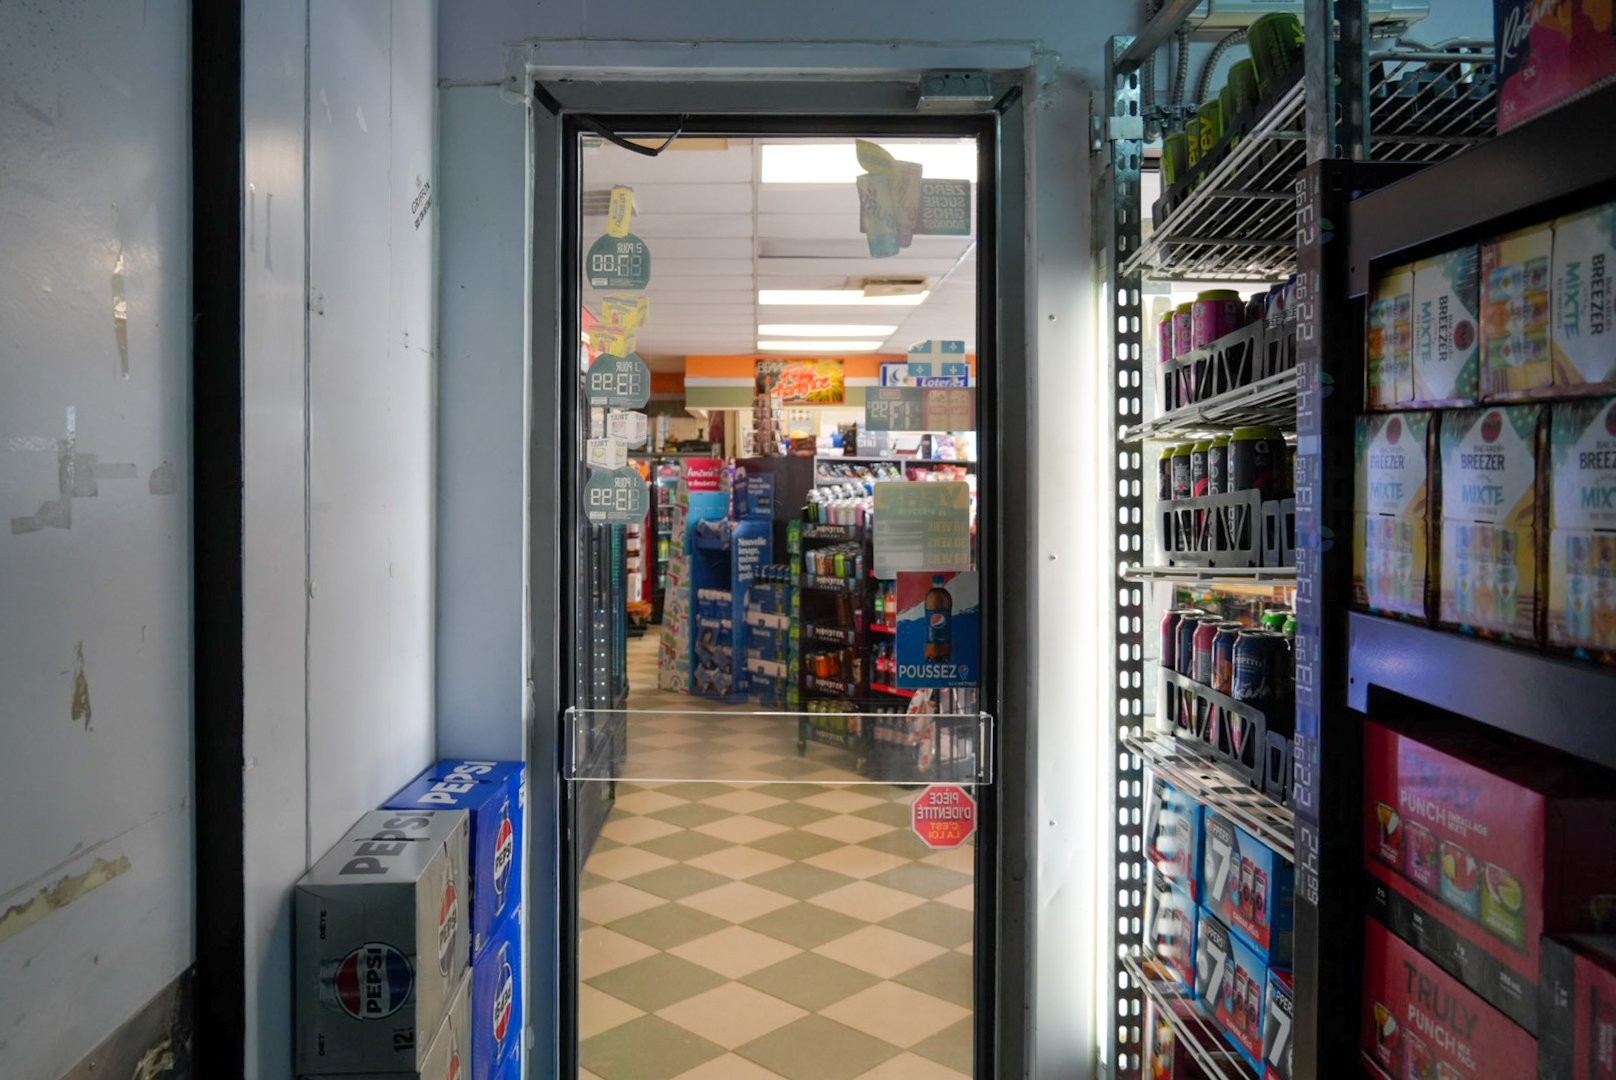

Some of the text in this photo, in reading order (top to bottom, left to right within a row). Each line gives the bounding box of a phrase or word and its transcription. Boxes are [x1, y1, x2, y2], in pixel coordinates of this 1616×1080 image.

[1295, 178, 1314, 249] 23.99
[1296, 272, 1313, 341] 22.99
[1565, 262, 1581, 340] MIXTE
[1590, 253, 1605, 336] BREEZER
[1421, 300, 1432, 365] MIXTE
[1438, 295, 1448, 362] BREEZER
[1296, 362, 1313, 418] 14.99
[1296, 457, 1313, 513] 13.99
[1370, 455, 1404, 470] BREEZER
[1370, 482, 1404, 501] MIXTE
[1461, 454, 1505, 471] BREEZER
[1461, 485, 1505, 506] MIXTE
[899, 664, 957, 679] POUSSEZ
[417, 760, 497, 805] PEPSI
[1294, 733, 1311, 805] 22.99
[1399, 789, 1446, 826] PUNCH
[339, 811, 435, 875] PEPSI
[495, 842, 512, 871] PEPSI
[1211, 836, 1232, 903] 7
[1300, 827, 1319, 904] 24.99
[367, 948, 382, 1013] PEPSI
[1205, 941, 1226, 1006] 7
[1271, 987, 1294, 1018] PPER
[1403, 961, 1479, 1040] TRULY
[393, 1030, 414, 1053] 12
[1269, 1000, 1292, 1066] 7
[1407, 1003, 1456, 1053] PUNCH
